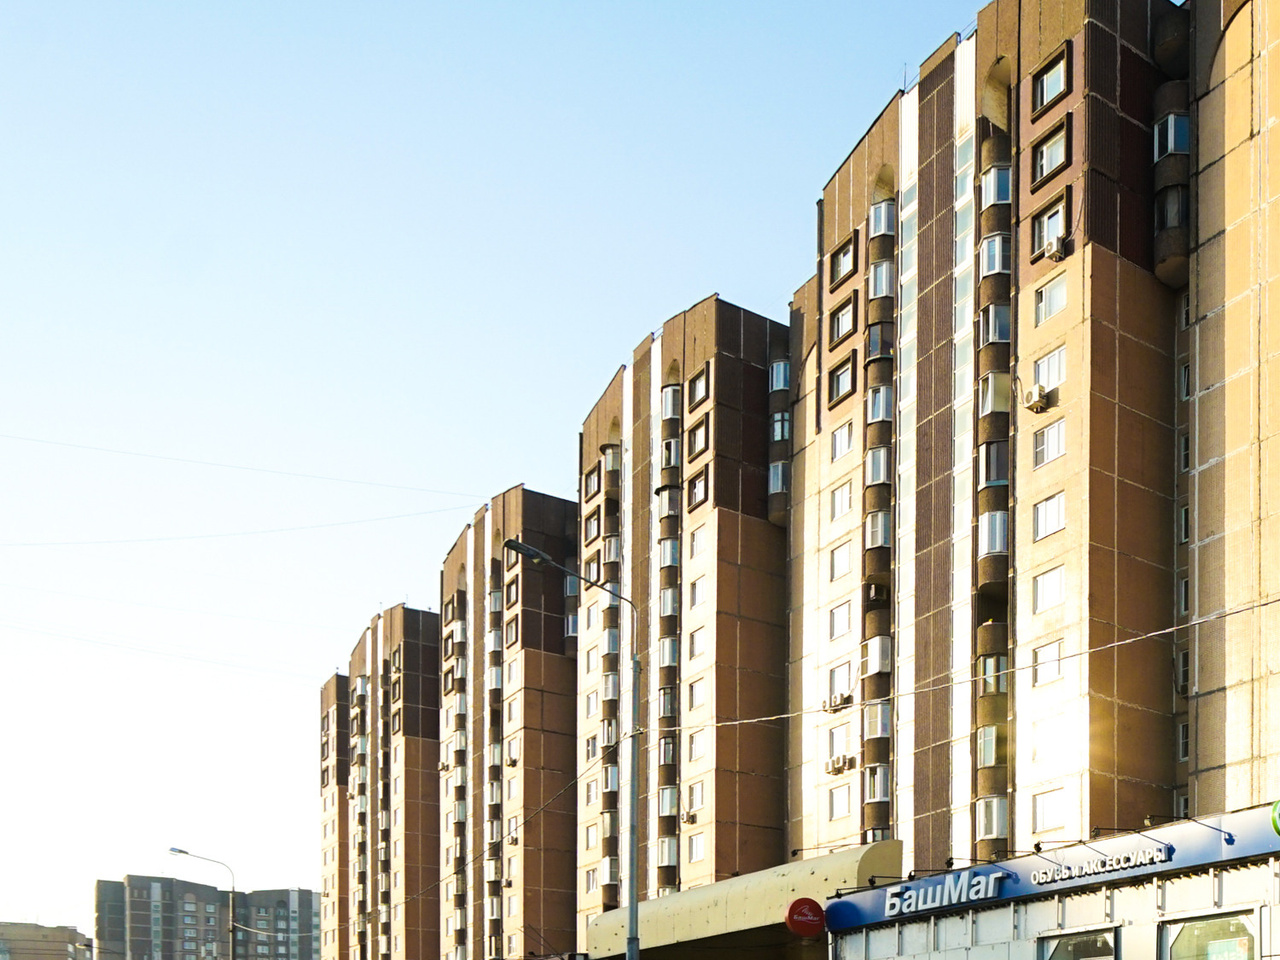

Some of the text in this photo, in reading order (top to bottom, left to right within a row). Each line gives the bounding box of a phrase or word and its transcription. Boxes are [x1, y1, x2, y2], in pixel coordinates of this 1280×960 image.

[1030, 865, 1072, 886] ОБУВЬ
[1081, 845, 1170, 876] АКСЕССУАРЫ
[884, 871, 1008, 918] БашМаг
